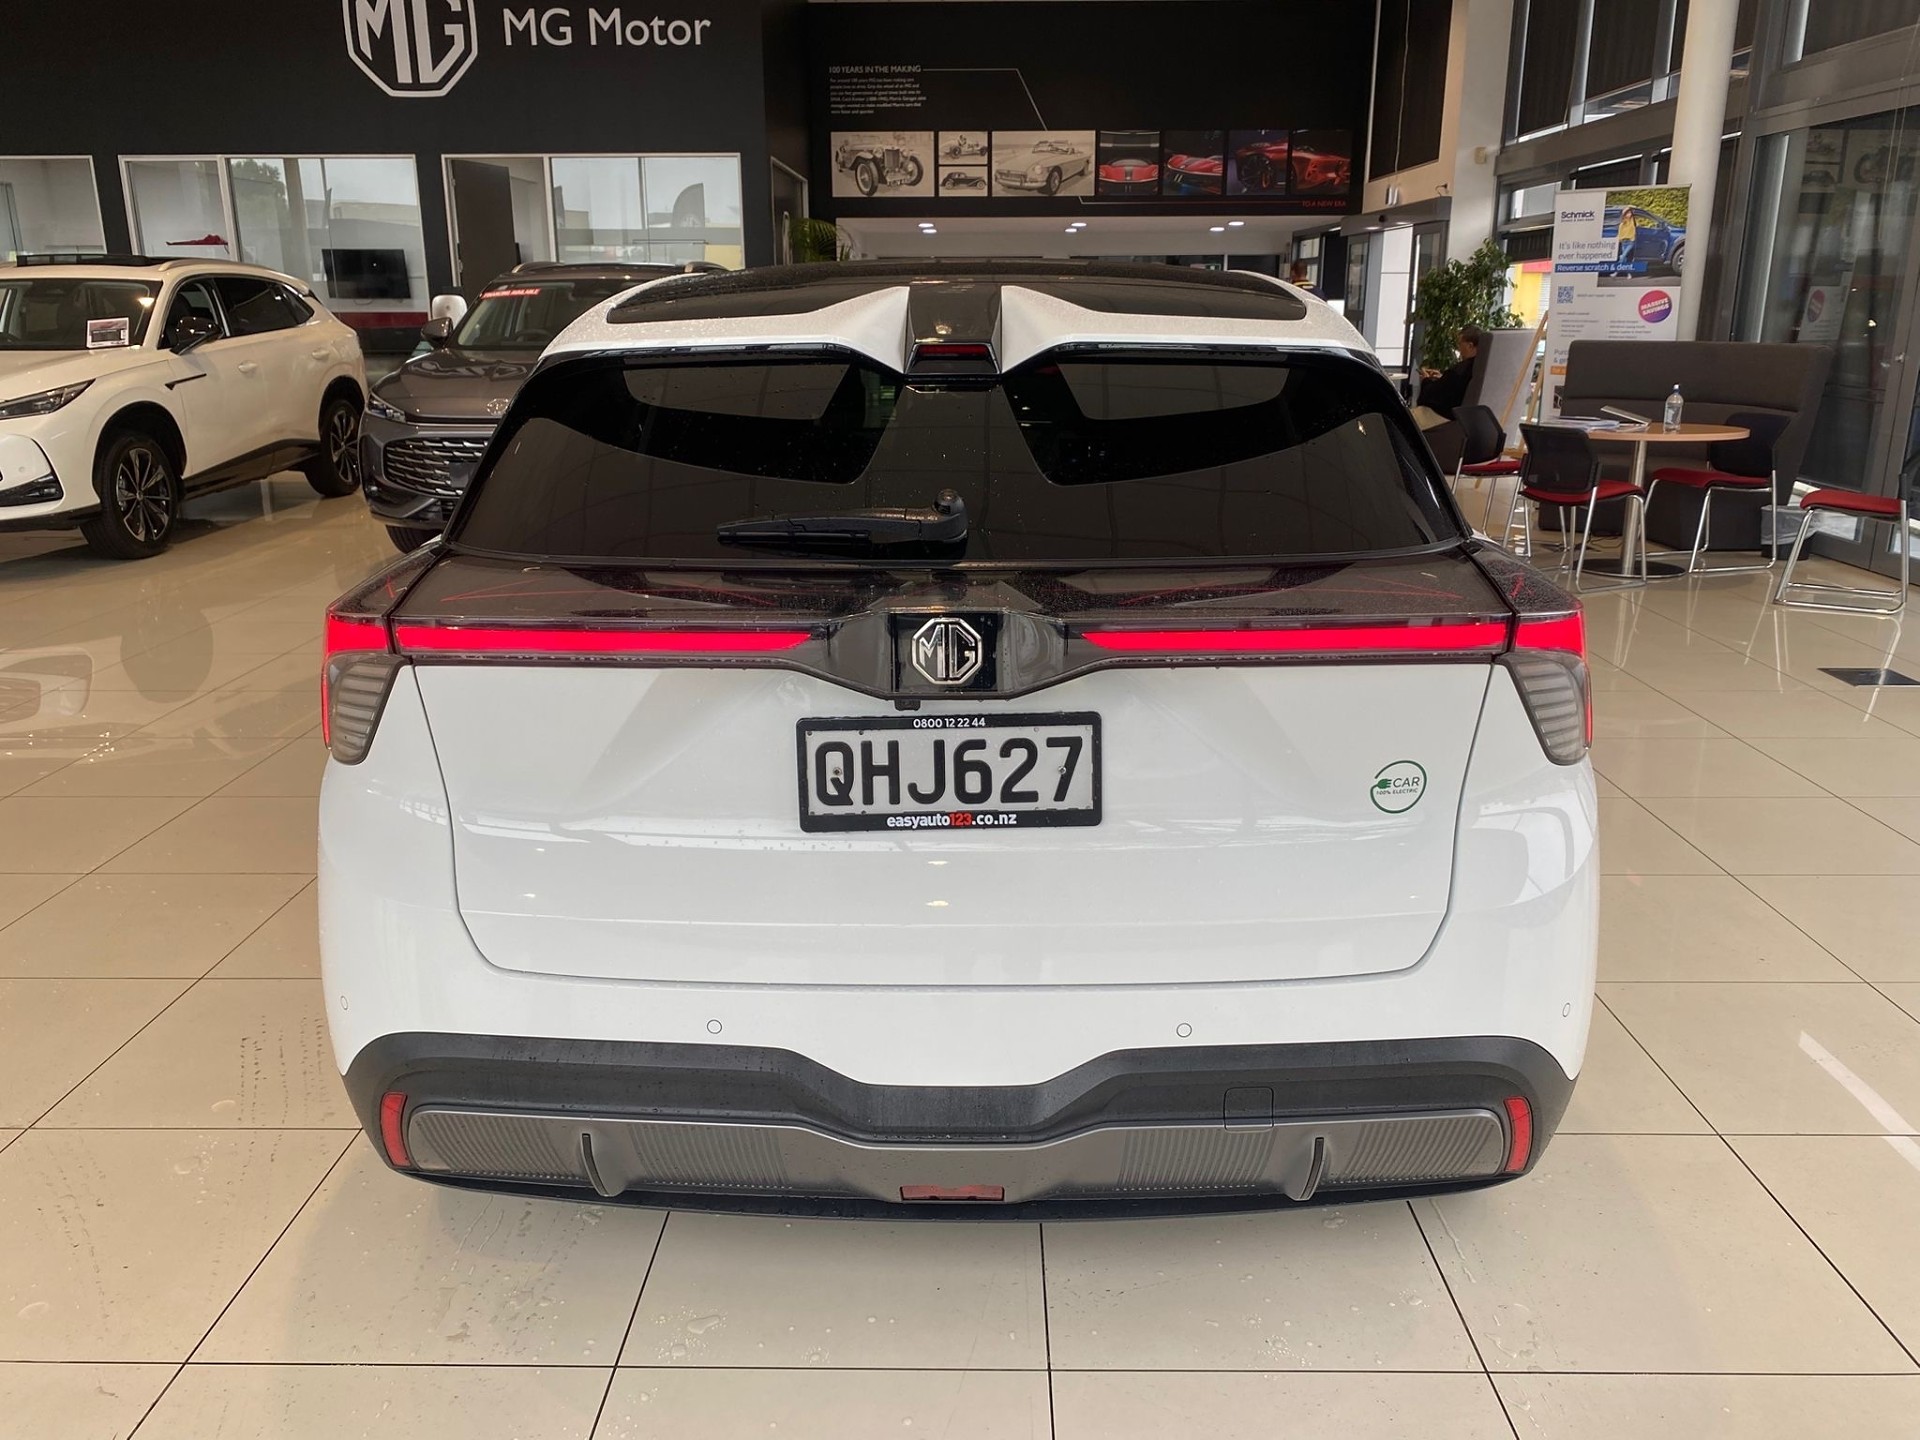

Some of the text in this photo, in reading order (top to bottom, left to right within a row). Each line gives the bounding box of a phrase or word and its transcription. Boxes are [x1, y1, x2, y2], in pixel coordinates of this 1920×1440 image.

[503, 8, 711, 46] MG Motor
[355, 0, 465, 84] MG
[890, 65, 921, 73] MAKING
[1561, 211, 1595, 219] Schmick
[1559, 241, 1616, 250] It's like nothing
[919, 623, 977, 679] MG
[913, 717, 986, 729] 0800 12 22 44
[815, 736, 1083, 806] QHJ627
[886, 812, 1017, 829] easyauto123.co.nz
